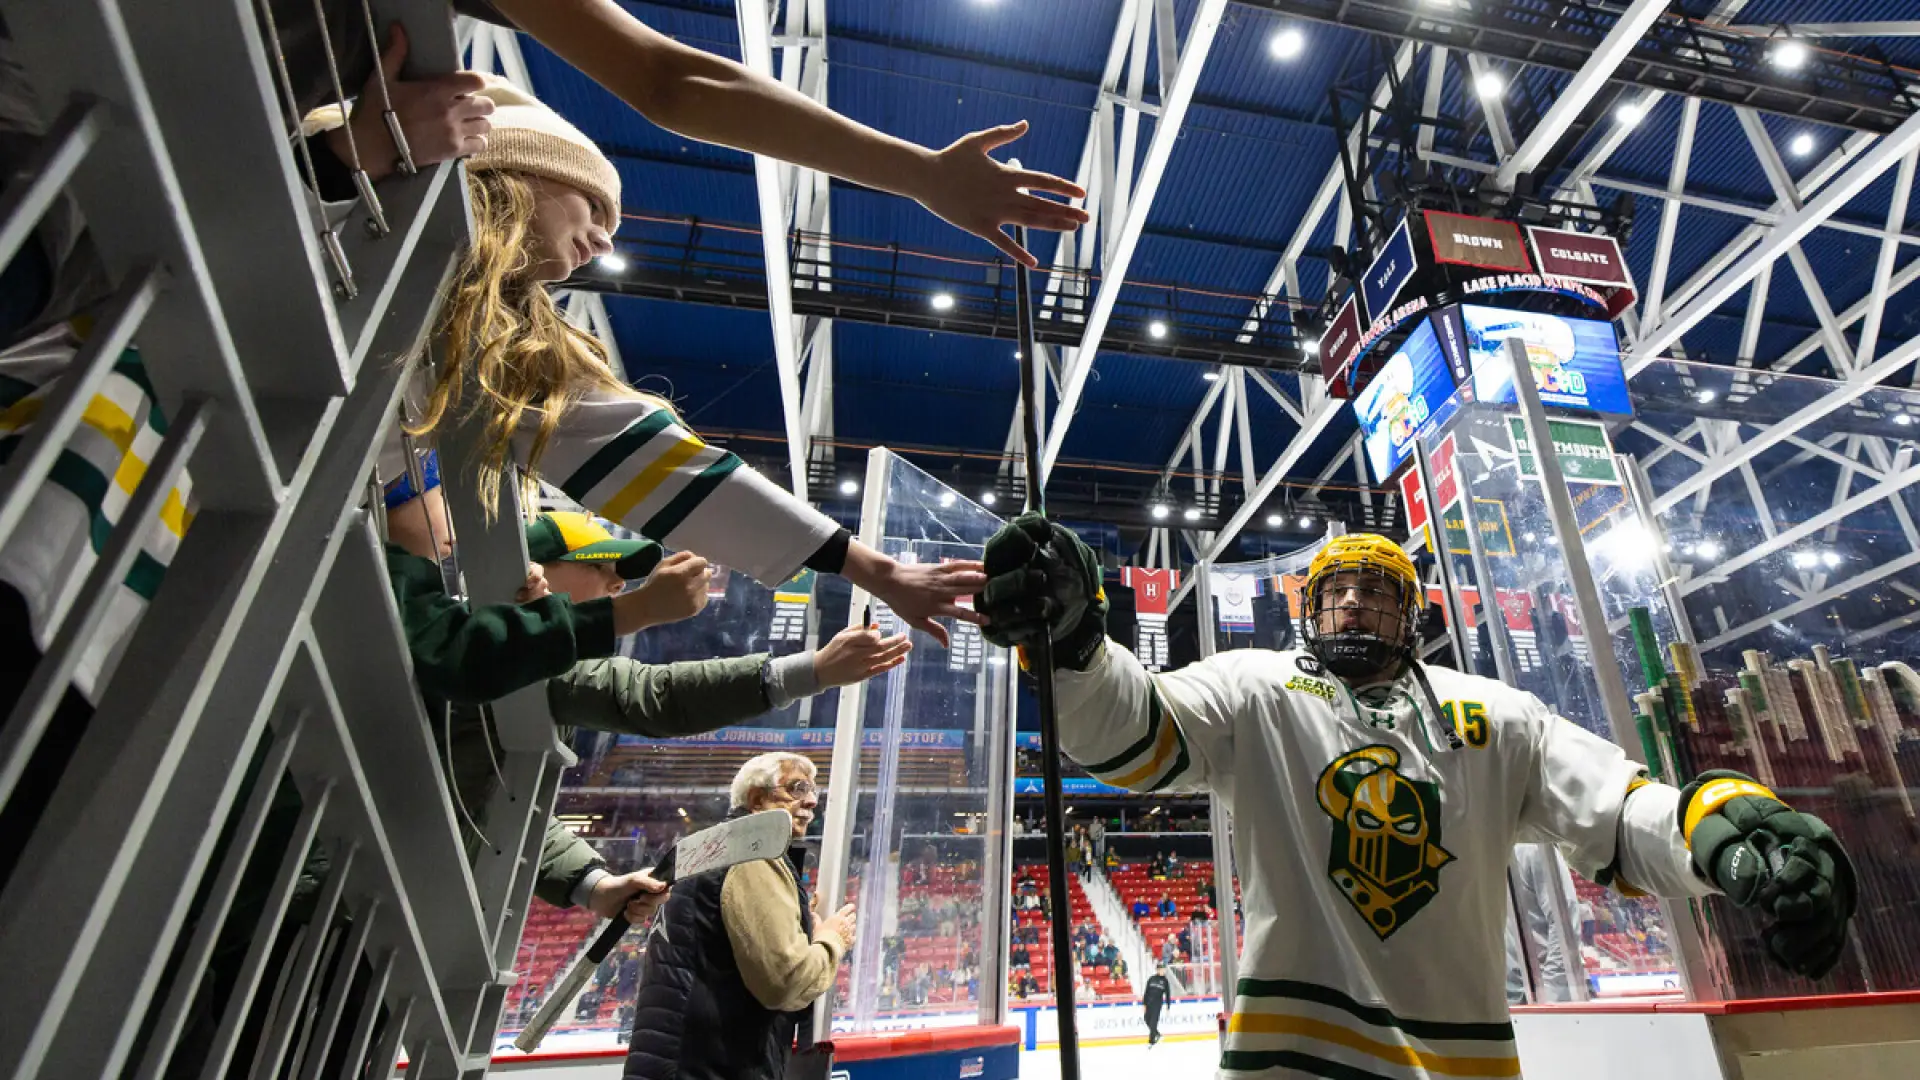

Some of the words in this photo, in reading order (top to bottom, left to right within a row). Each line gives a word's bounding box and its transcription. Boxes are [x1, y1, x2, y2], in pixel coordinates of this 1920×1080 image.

[1452, 233, 1503, 249] BROWN
[1550, 247, 1609, 265] COLGATE
[1463, 276, 1497, 294] LAKE
[1498, 273, 1542, 288] PLACID
[1392, 295, 1428, 324] ARENA
[1146, 583, 1157, 597] H
[1291, 675, 1337, 693] ECAC
[1440, 699, 1491, 750] 15
[721, 730, 785, 744] JOHNSON
